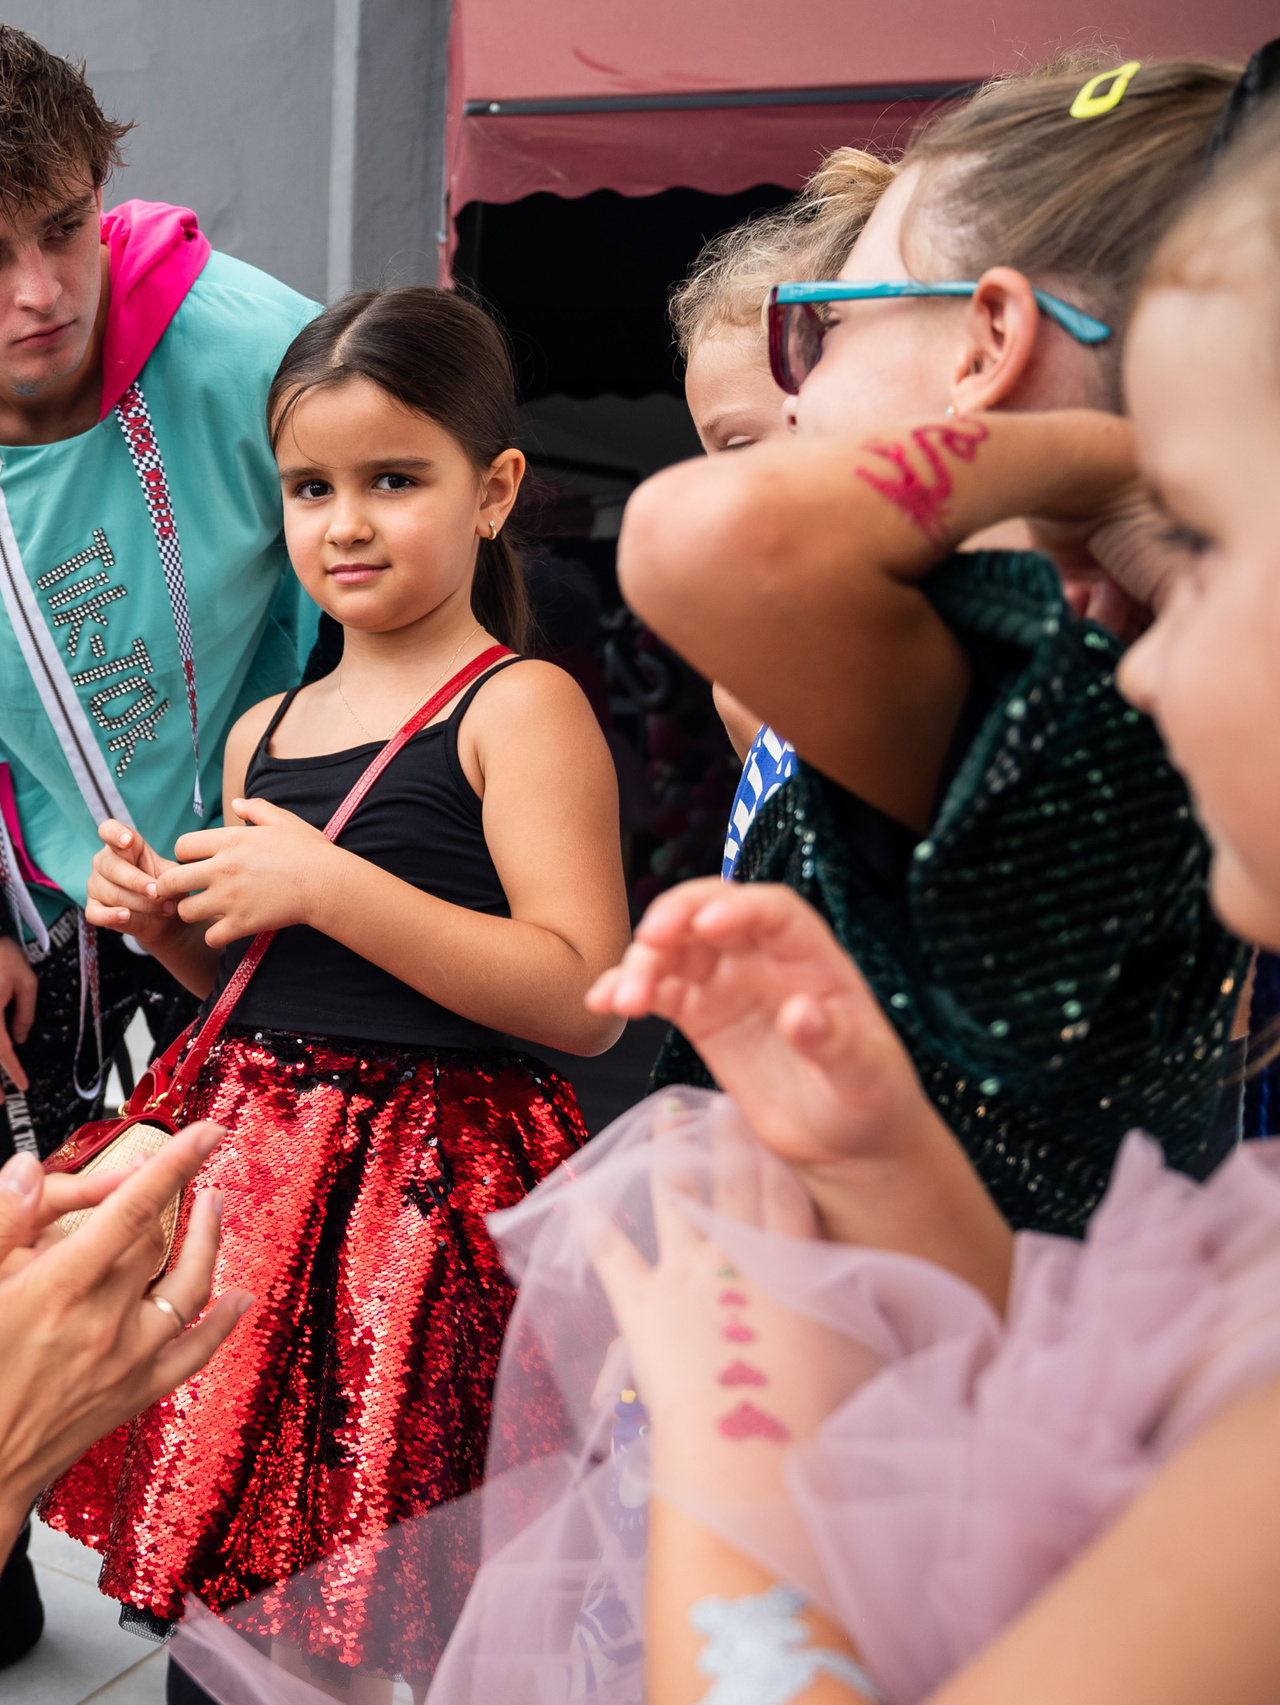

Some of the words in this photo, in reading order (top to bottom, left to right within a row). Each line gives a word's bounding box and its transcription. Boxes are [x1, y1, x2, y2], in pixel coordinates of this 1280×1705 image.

[120, 391, 155, 456] BLACK
[143, 468, 175, 540] WHITE
[5, 1090, 32, 1131] TALK
